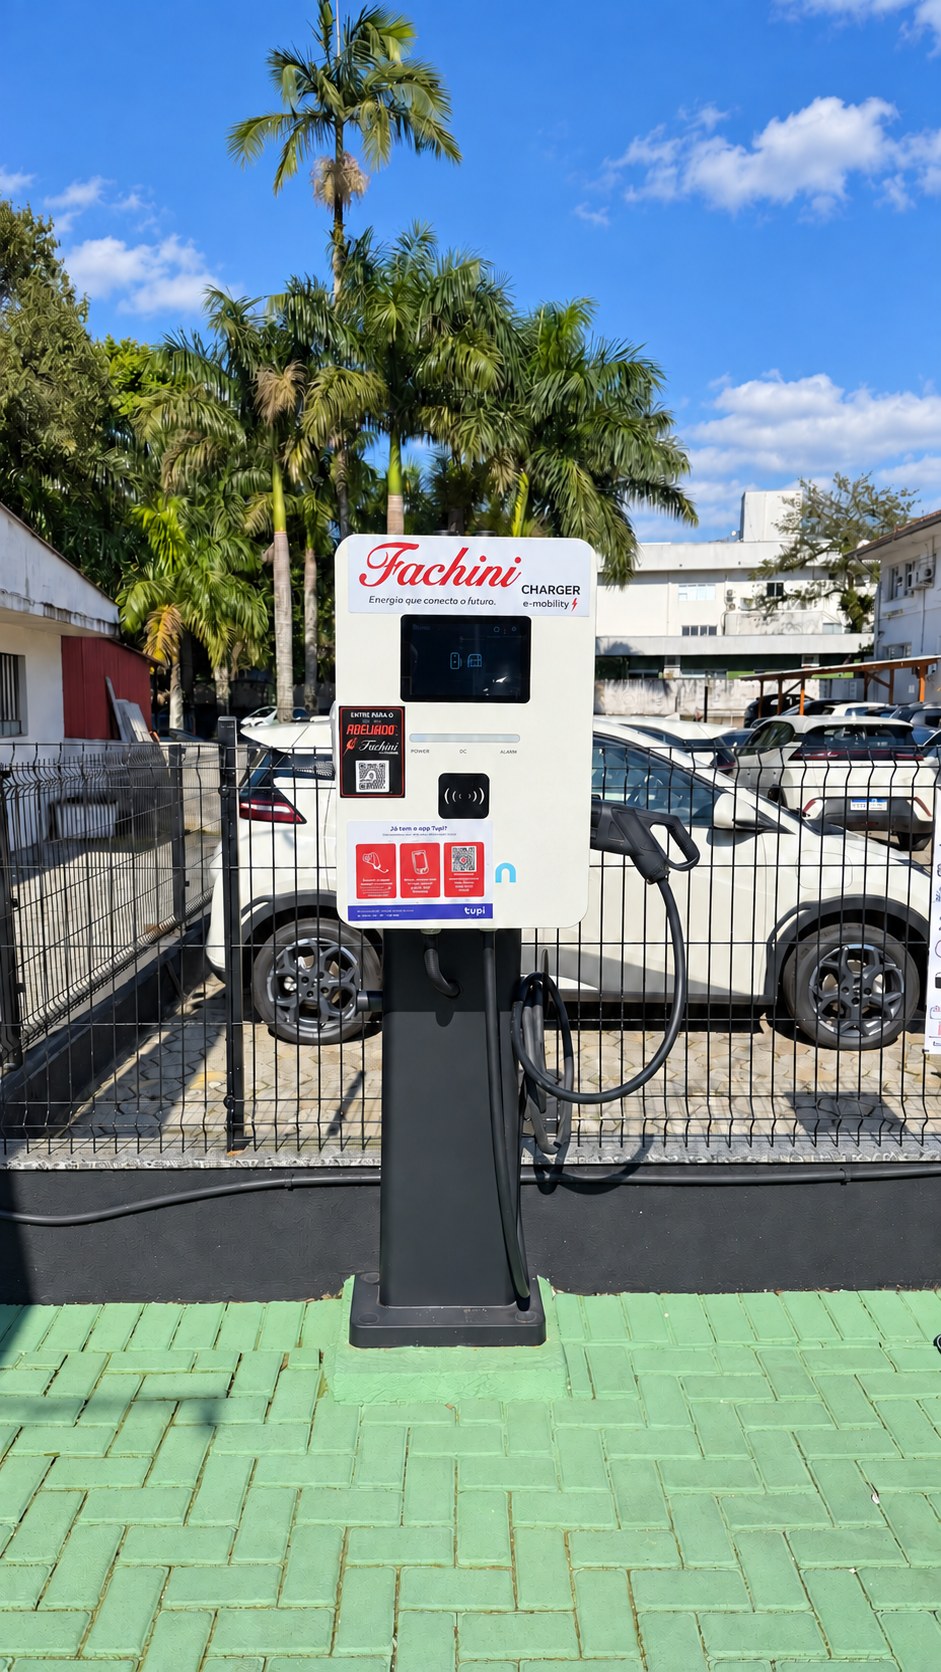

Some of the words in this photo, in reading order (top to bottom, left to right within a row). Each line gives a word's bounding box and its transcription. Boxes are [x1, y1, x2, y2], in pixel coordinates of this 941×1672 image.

[359, 542, 522, 588] Fachini
[521, 584, 581, 596] CHARGER
[405, 598, 423, 606] que
[467, 596, 497, 606] futuro.
[522, 599, 570, 610] e-mobility
[358, 739, 400, 751] Fachini
[464, 906, 486, 917] tupi
